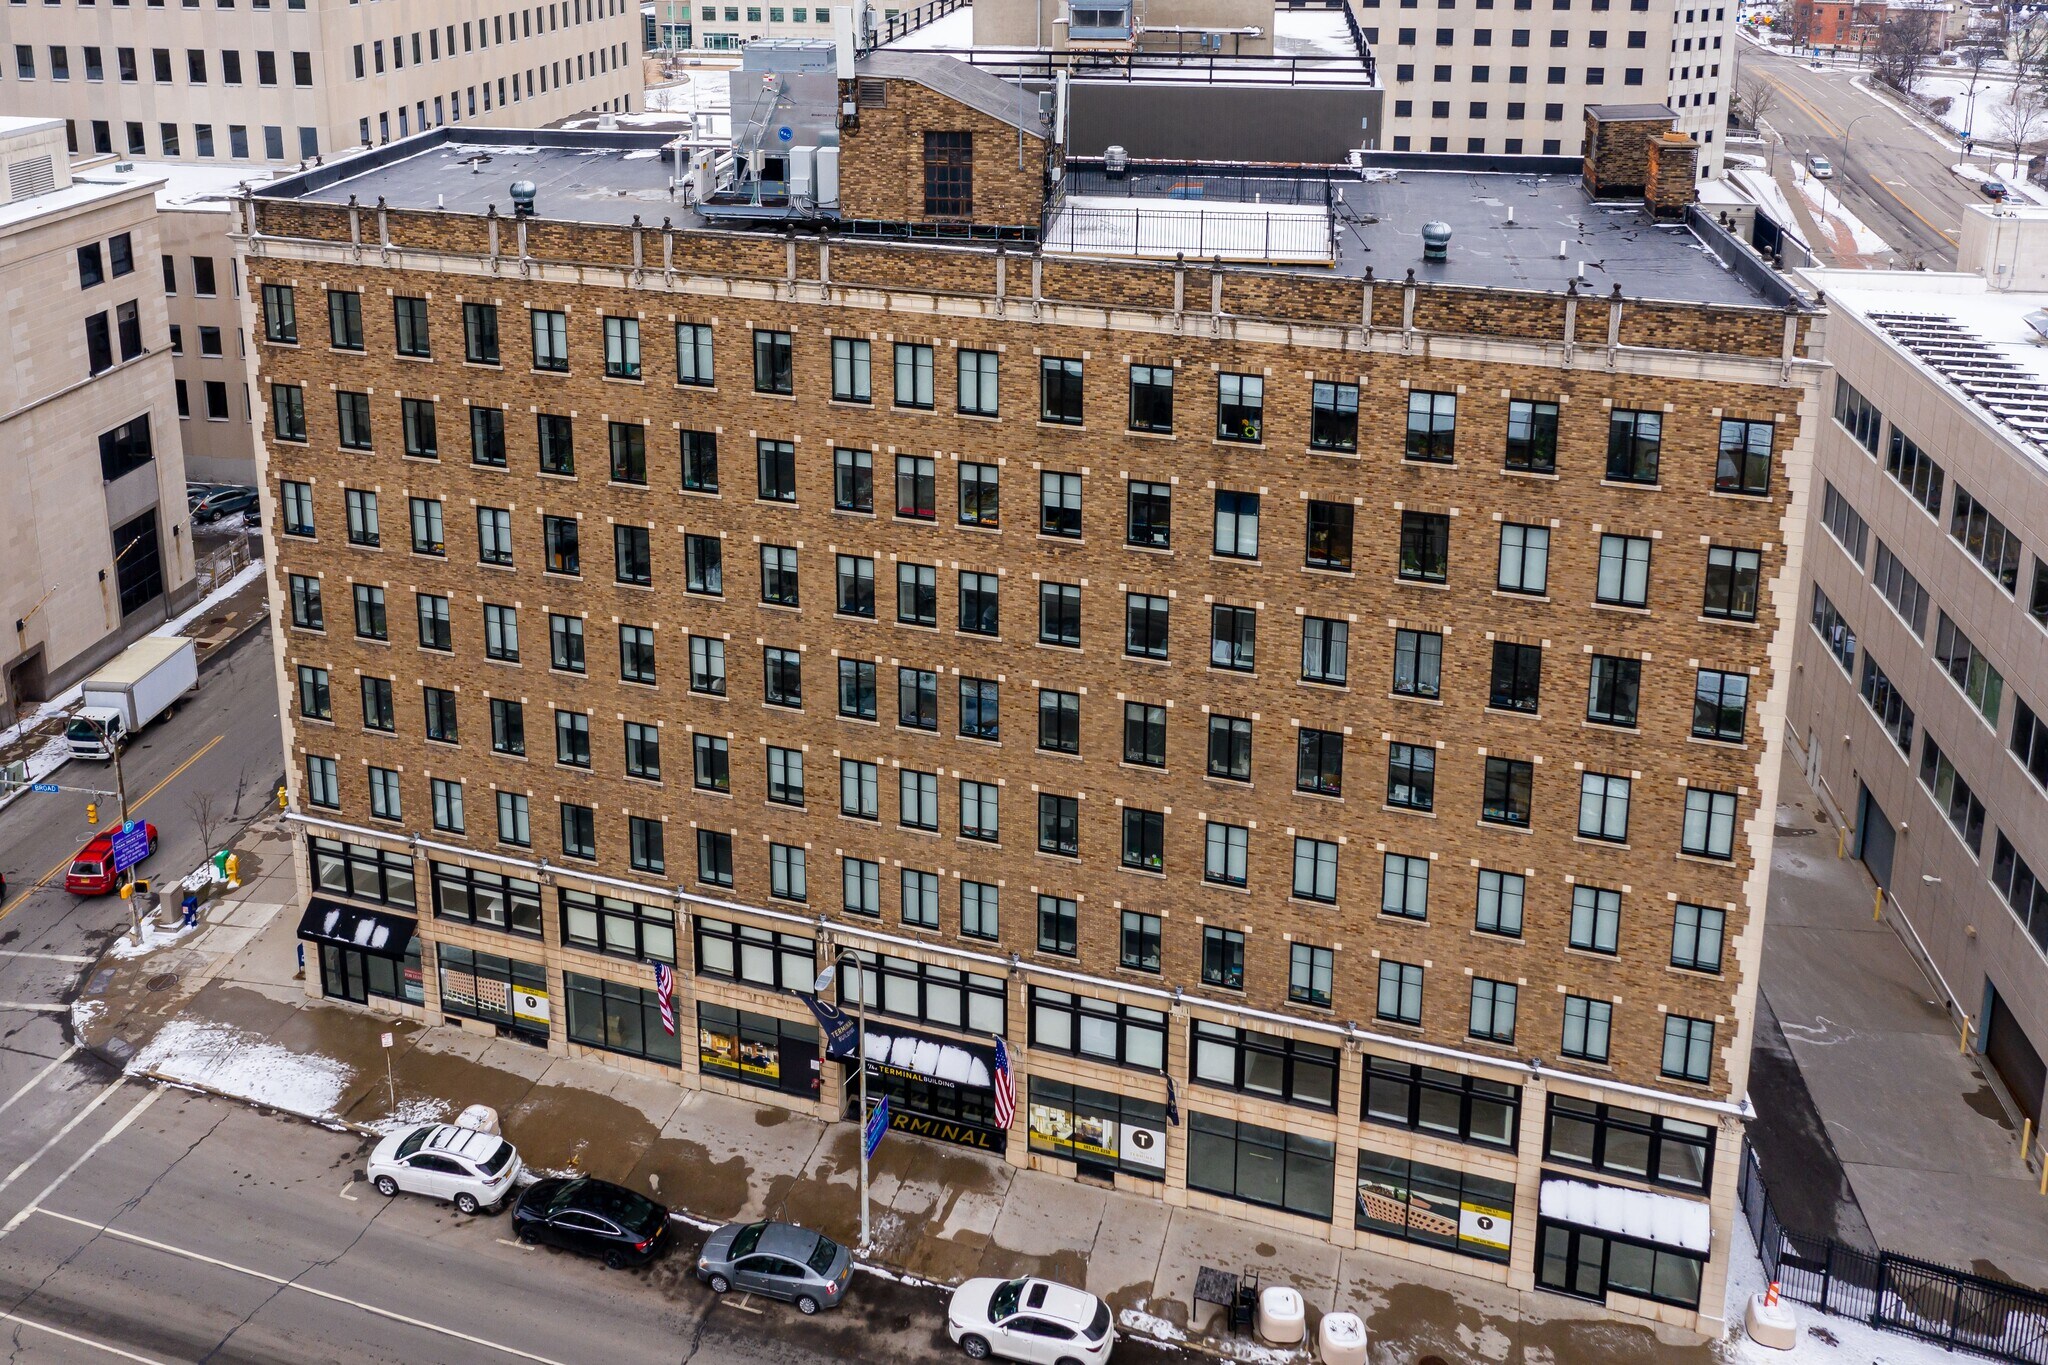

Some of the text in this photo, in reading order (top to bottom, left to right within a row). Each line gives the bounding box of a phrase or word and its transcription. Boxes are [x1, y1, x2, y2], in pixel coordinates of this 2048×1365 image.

[879, 1065, 923, 1082] TERMINAL
[923, 1076, 955, 1089] BUILDING
[1138, 1133, 1148, 1147] T
[1481, 1218, 1489, 1229] T
